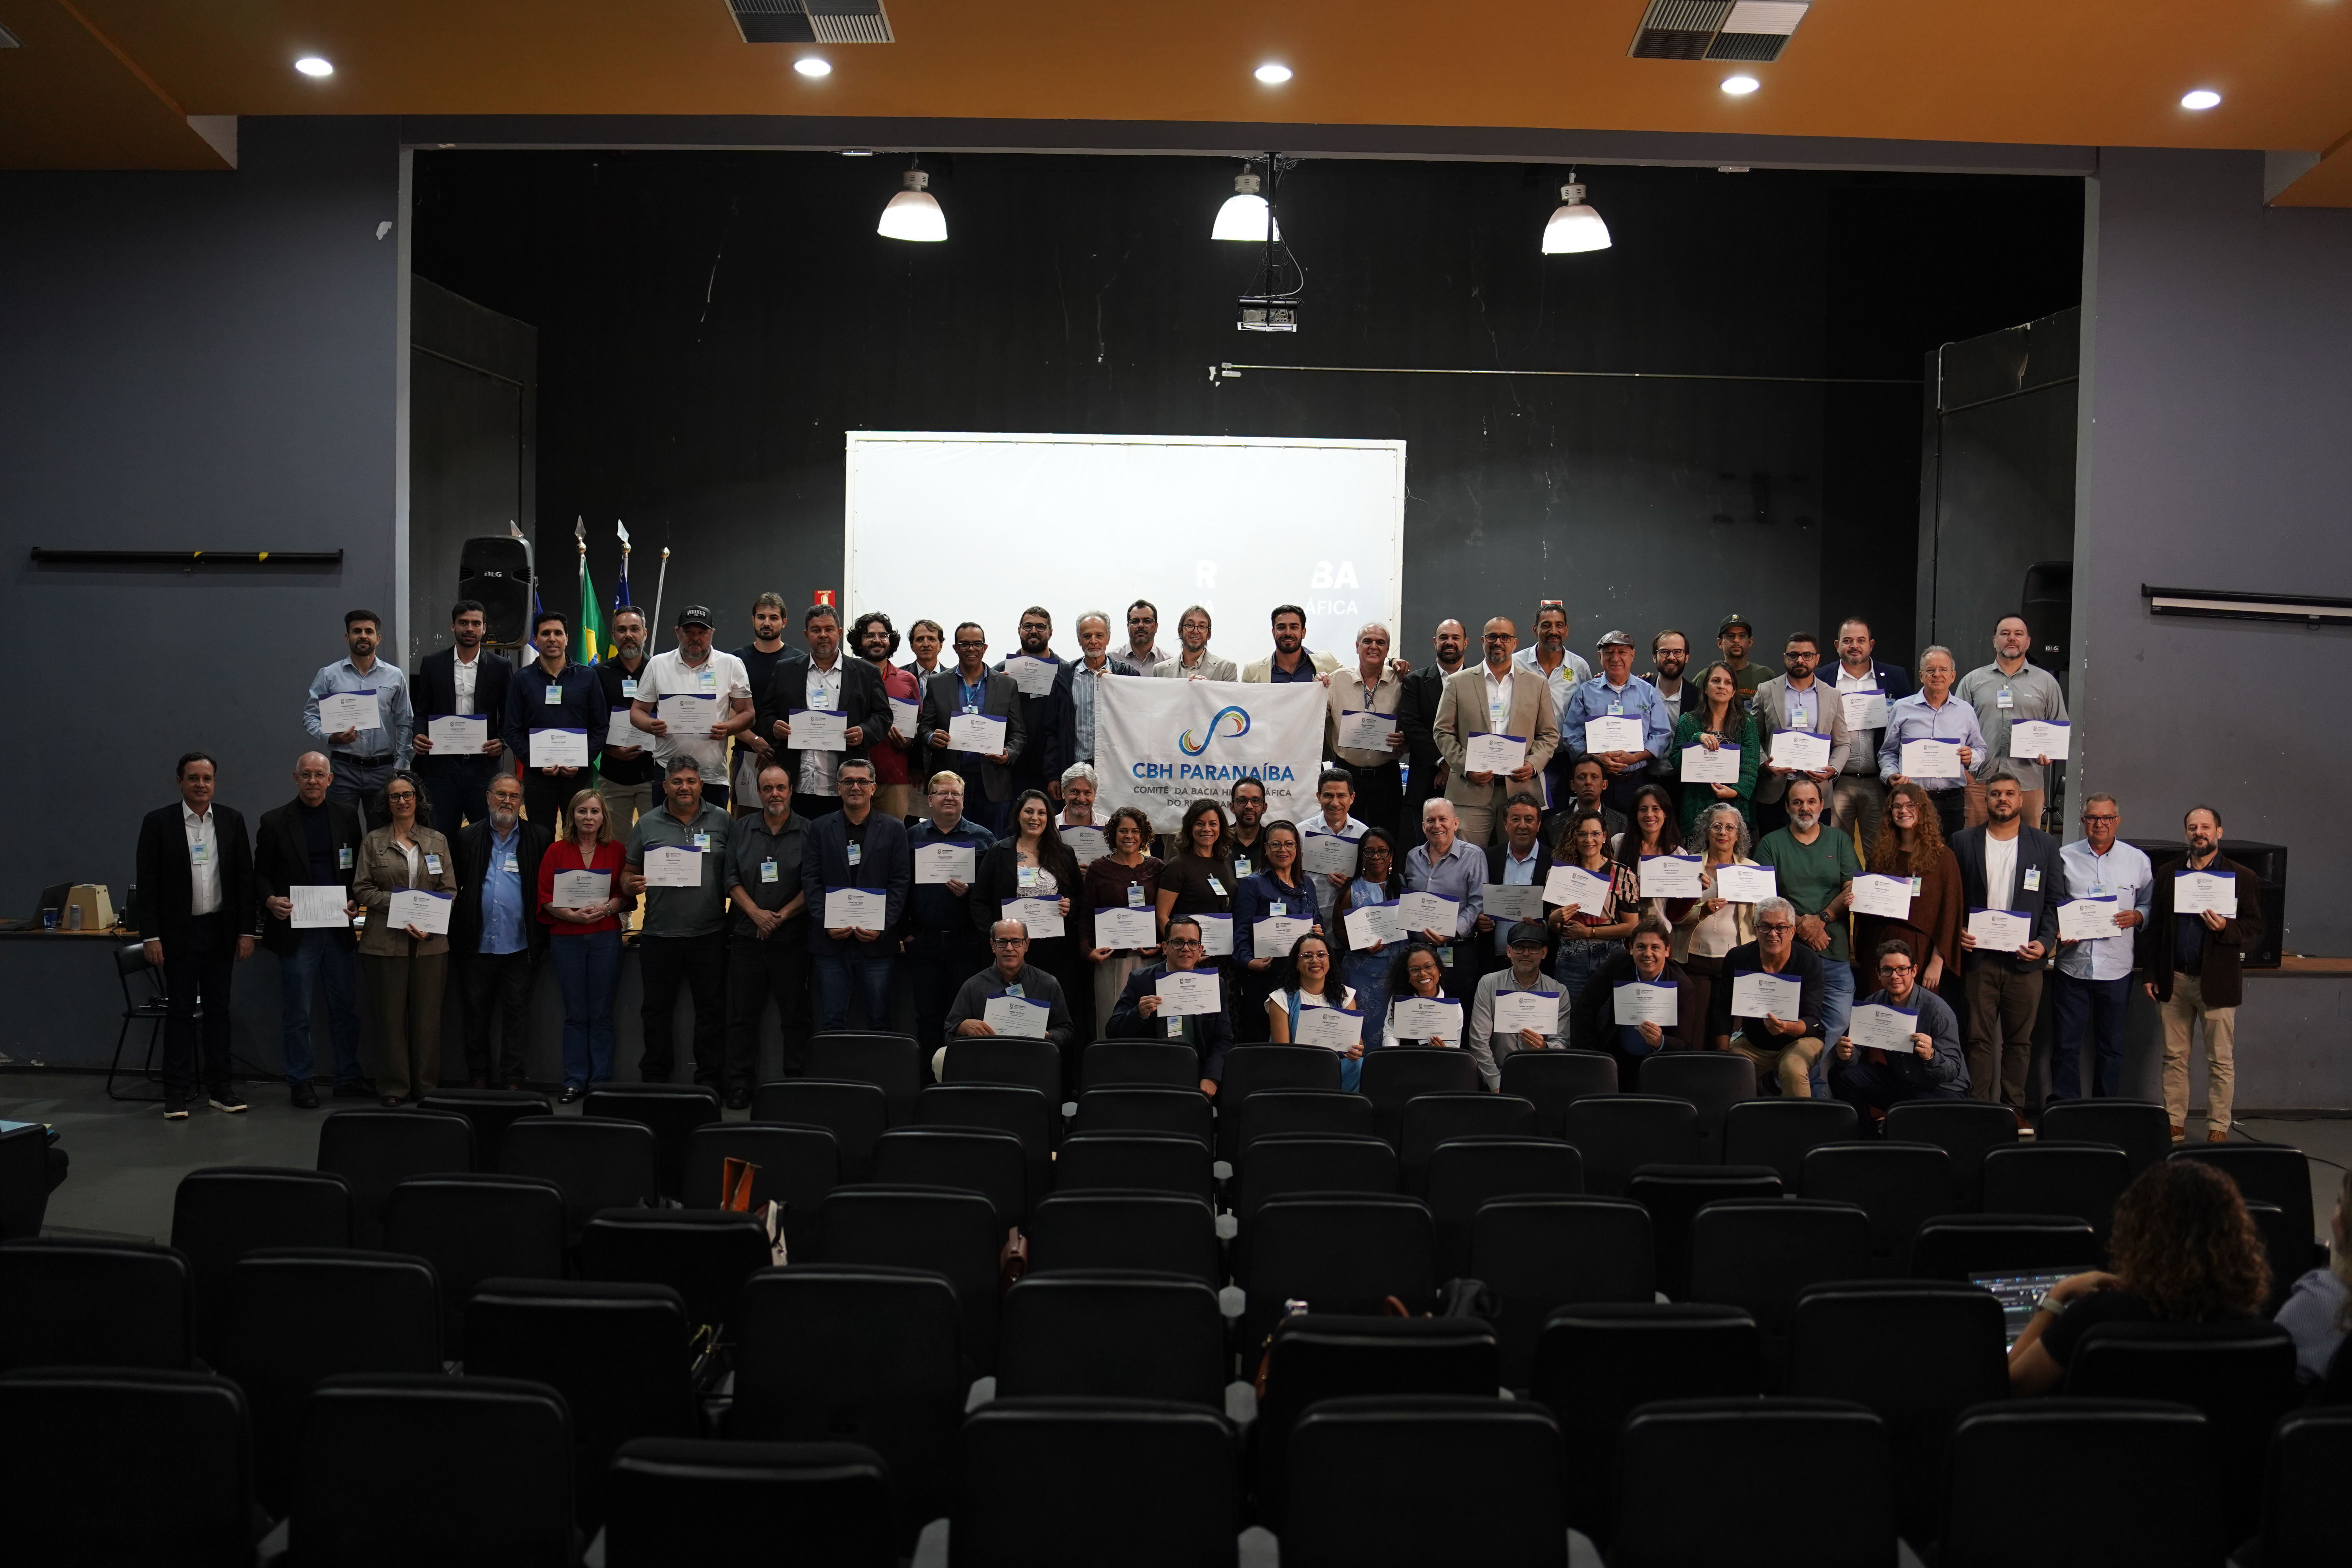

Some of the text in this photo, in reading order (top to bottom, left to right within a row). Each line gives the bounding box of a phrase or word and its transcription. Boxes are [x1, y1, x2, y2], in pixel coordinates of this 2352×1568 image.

[1132, 762, 1295, 781] CBH PARANAÍBA
[1134, 786, 1169, 794] COMITÊ
